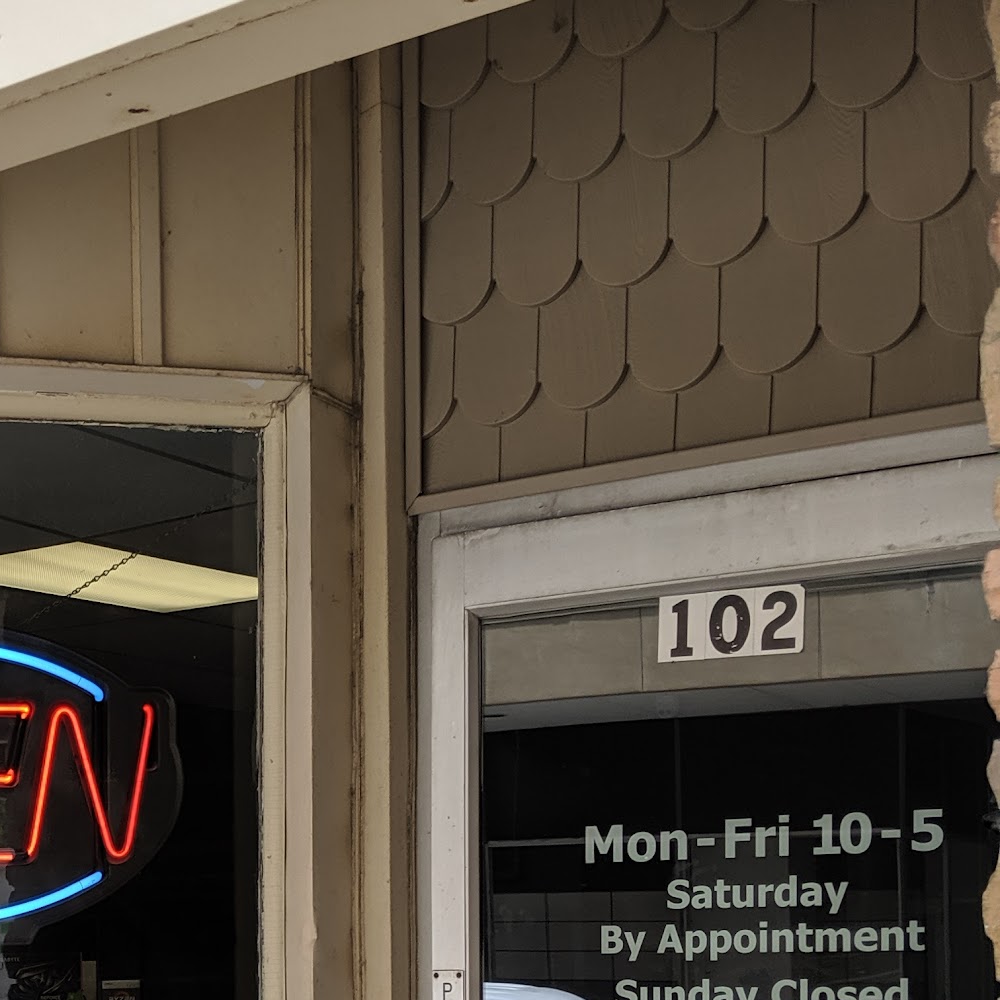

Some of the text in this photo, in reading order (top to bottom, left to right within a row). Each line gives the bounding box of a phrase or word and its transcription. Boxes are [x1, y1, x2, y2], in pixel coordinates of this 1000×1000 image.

[669, 590, 799, 658] 102
[666, 876, 849, 915] Saturday
[600, 919, 926, 962] By Appointment
